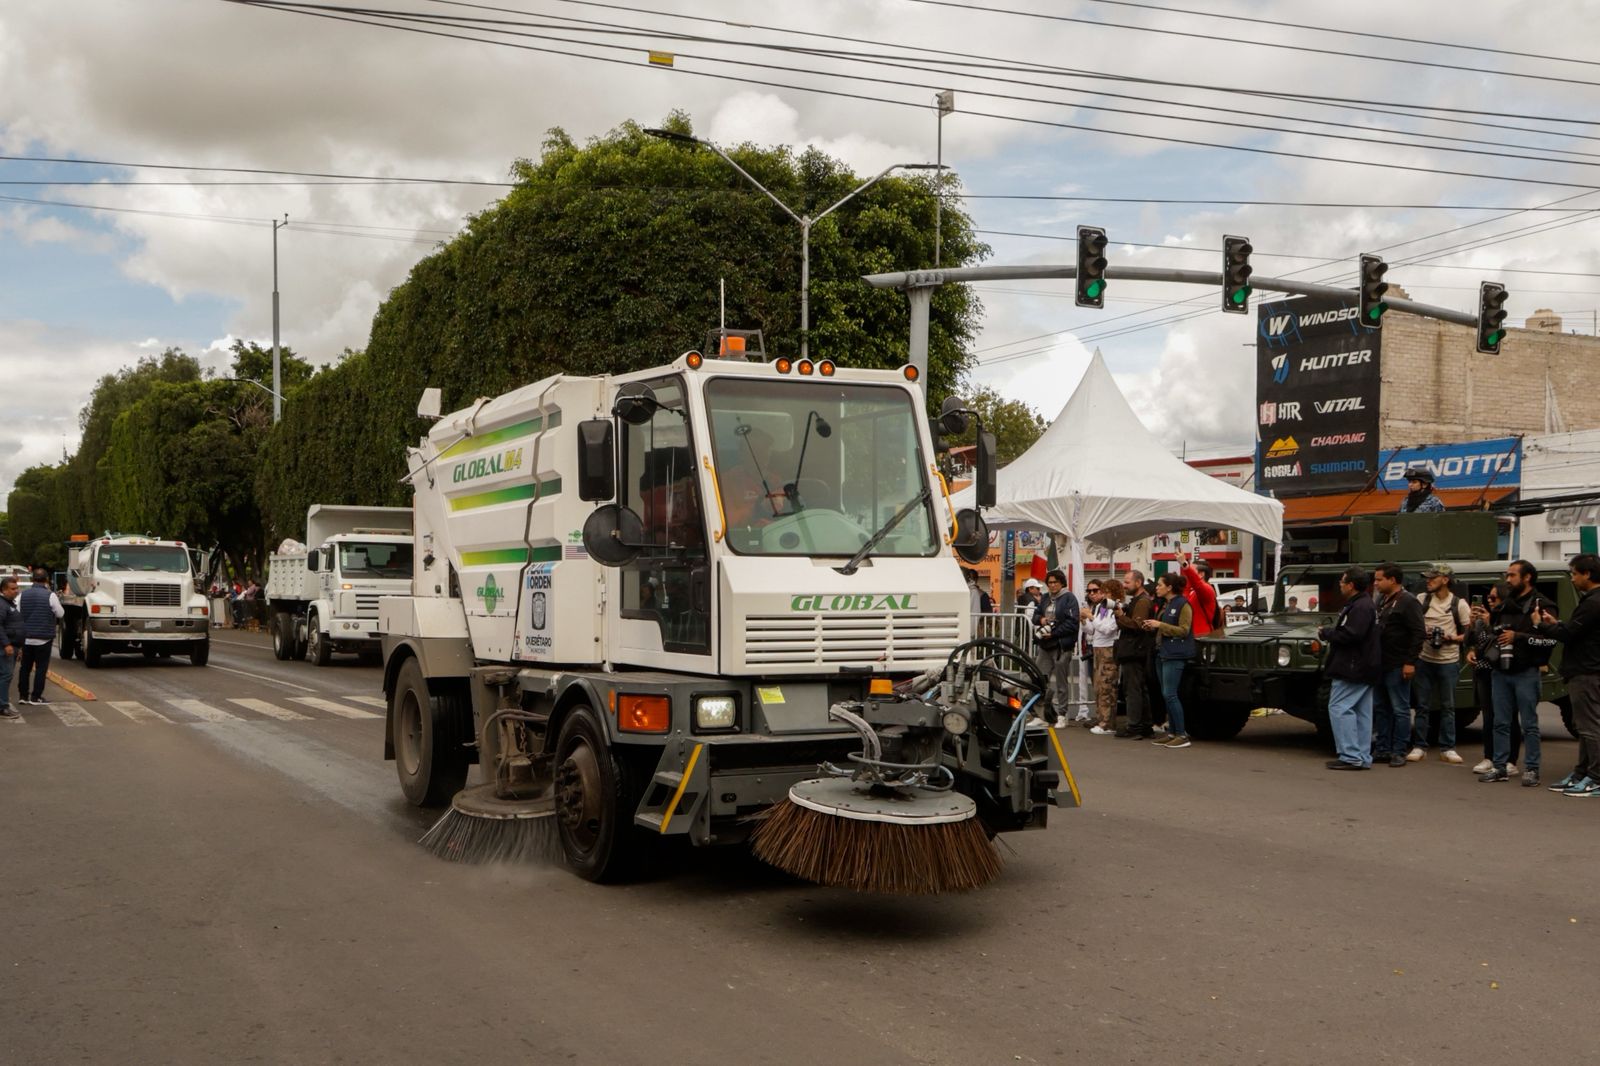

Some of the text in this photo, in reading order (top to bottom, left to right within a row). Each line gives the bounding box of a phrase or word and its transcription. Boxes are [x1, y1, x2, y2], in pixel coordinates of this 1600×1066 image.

[1299, 306, 1360, 328] WINDSO
[1299, 349, 1373, 372] HUNTER
[1278, 401, 1303, 421] HTR
[1310, 432, 1367, 448] CHAOYANG
[453, 453, 503, 483] GLOBAL
[1310, 460, 1366, 475] SHIMANO
[1384, 452, 1517, 481] BENOTTO
[529, 575, 552, 589] ORDEN
[791, 594, 918, 611] GLOBAL
[525, 634, 552, 647] QUERÉTARO
